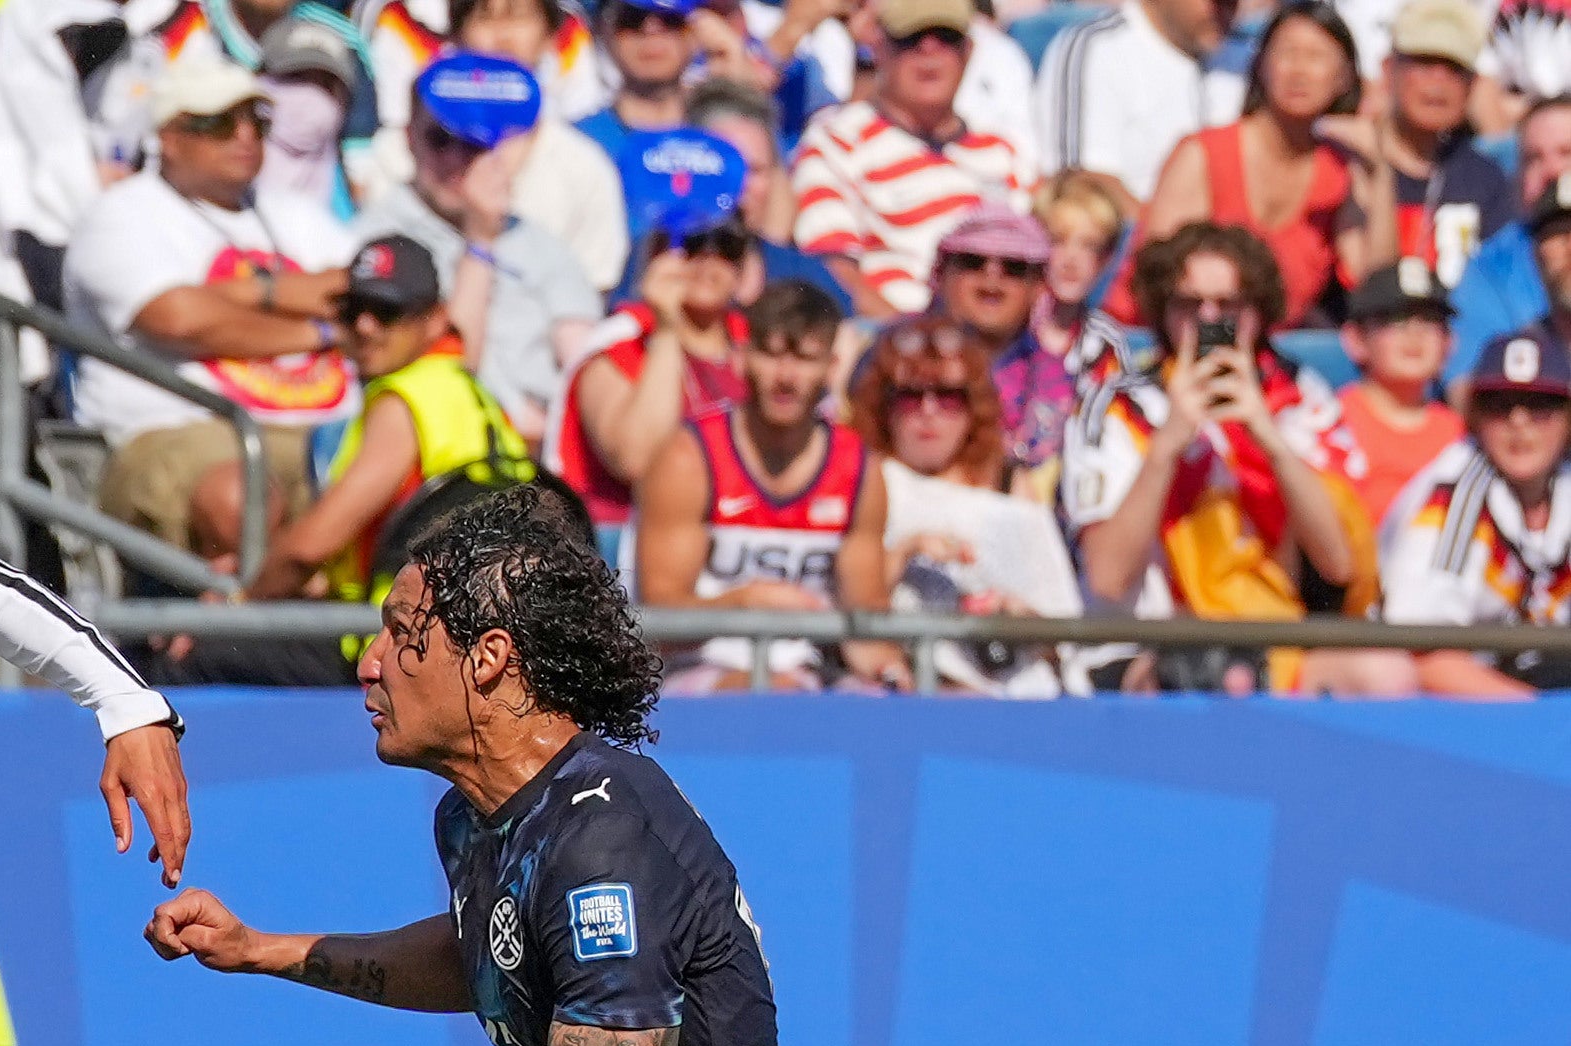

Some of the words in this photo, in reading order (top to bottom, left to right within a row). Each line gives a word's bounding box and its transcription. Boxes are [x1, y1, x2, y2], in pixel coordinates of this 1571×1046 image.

[707, 536, 837, 592] USA
[579, 895, 622, 910] FOOTBALL
[579, 906, 623, 926] UNITES
[597, 921, 627, 937] World
